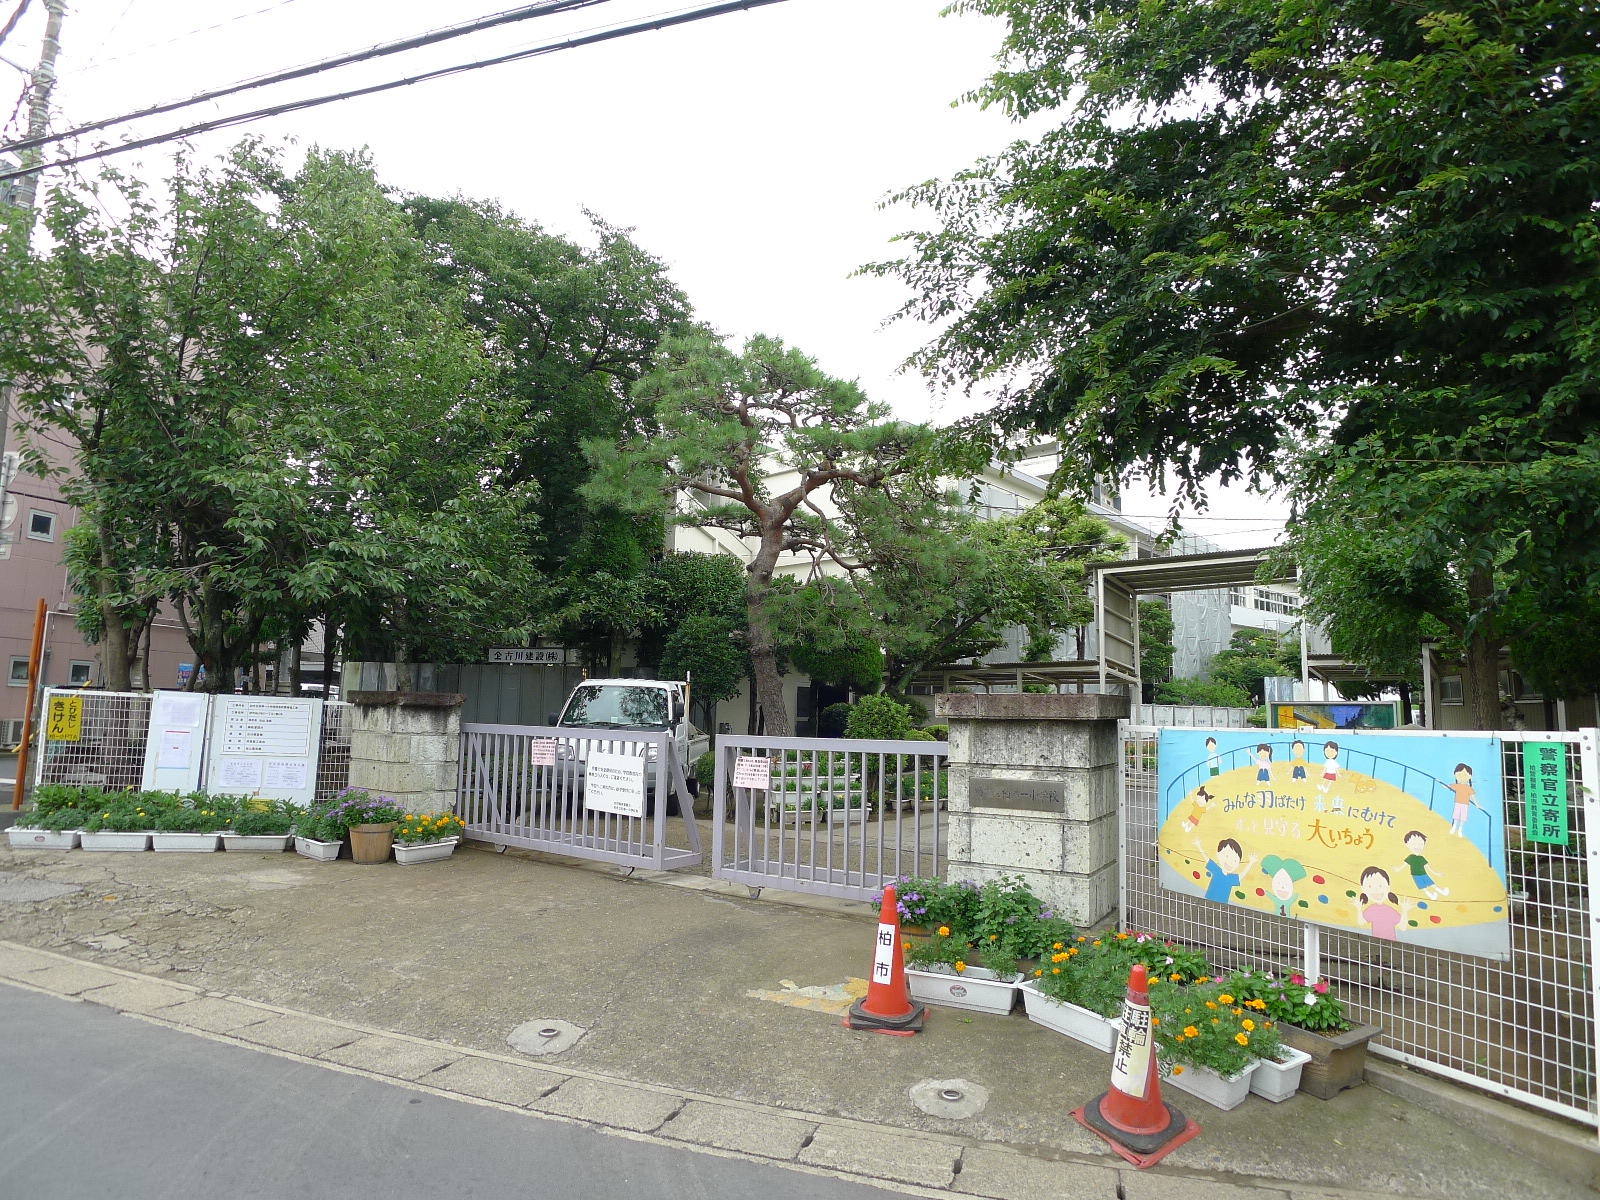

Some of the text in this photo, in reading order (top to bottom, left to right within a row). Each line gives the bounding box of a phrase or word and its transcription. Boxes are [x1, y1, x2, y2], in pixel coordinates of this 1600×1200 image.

[52, 701, 65, 733] きけん
[68, 700, 78, 729] とびだし
[1540, 747, 1561, 838] 警察官立寄所
[1347, 806, 1397, 829] にむけて
[1307, 818, 1374, 850] 大いちょう
[876, 929, 892, 977] 柏市
[1128, 1007, 1149, 1047] 駐輪
